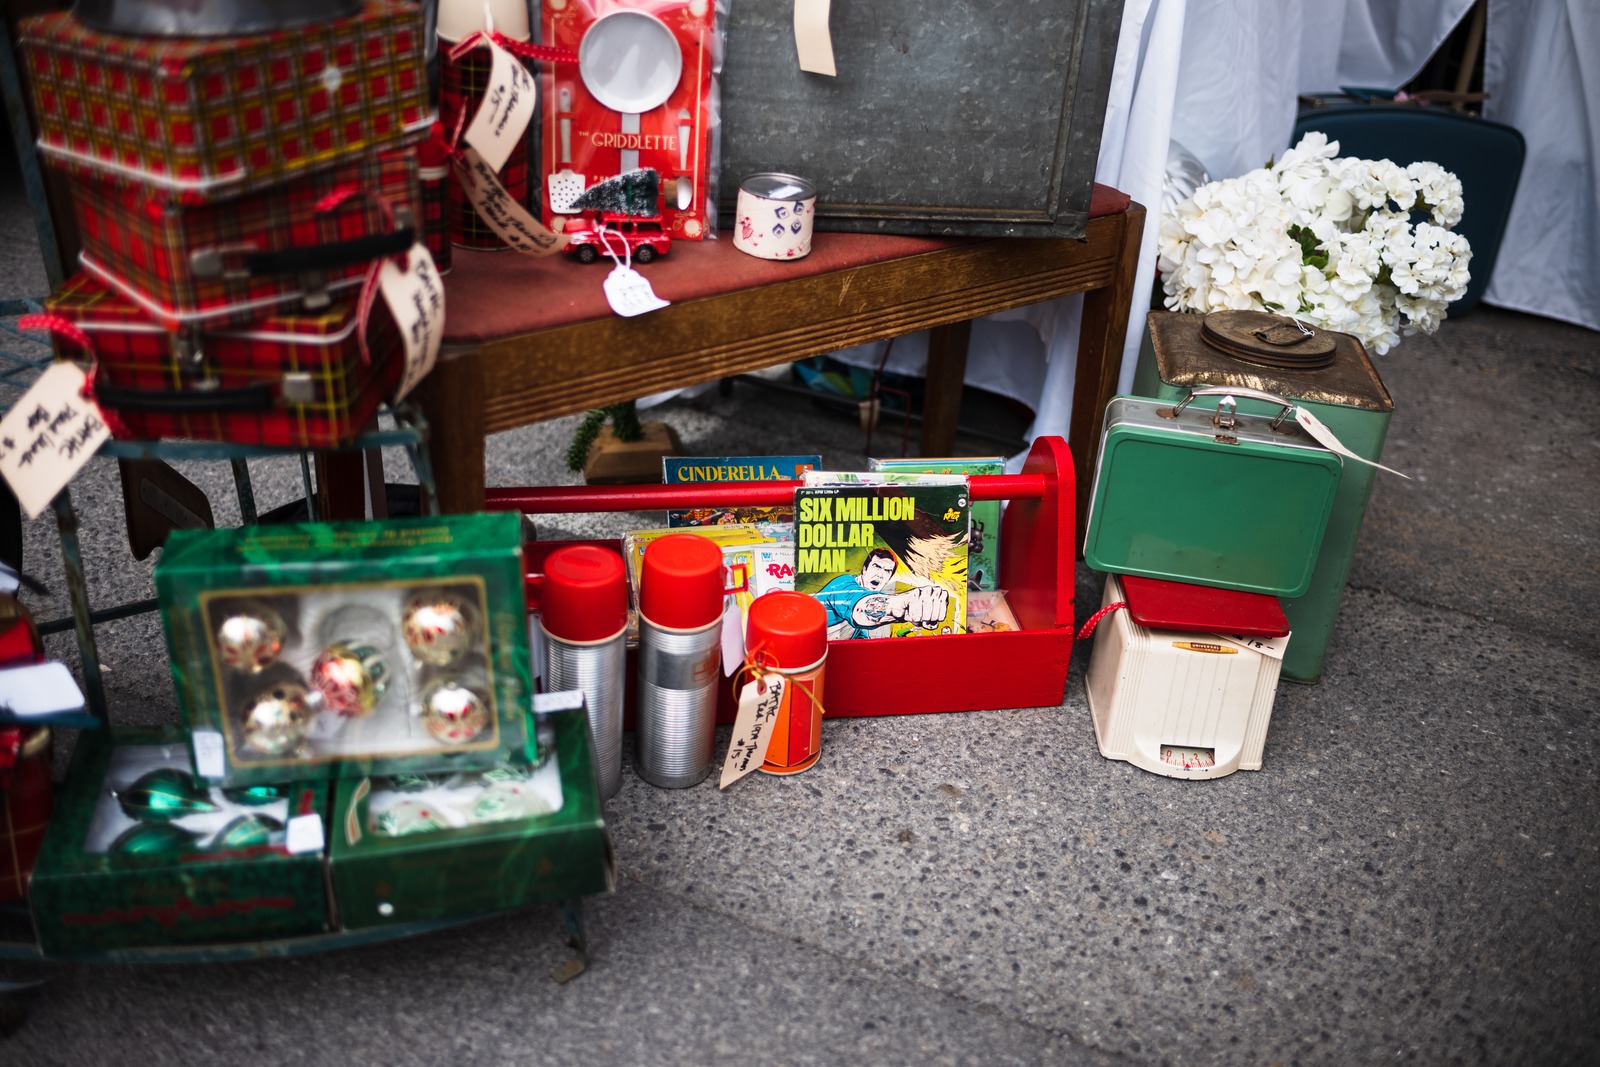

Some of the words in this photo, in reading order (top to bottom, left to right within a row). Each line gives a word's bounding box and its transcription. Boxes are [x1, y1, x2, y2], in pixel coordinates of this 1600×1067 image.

[591, 132, 677, 151] GRIDDLETTE
[677, 465, 780, 482] CINDERELLA
[800, 497, 832, 523] SIX
[836, 497, 915, 522] MILLION
[799, 523, 875, 548] DOLLAR
[798, 549, 846, 574] MAN
